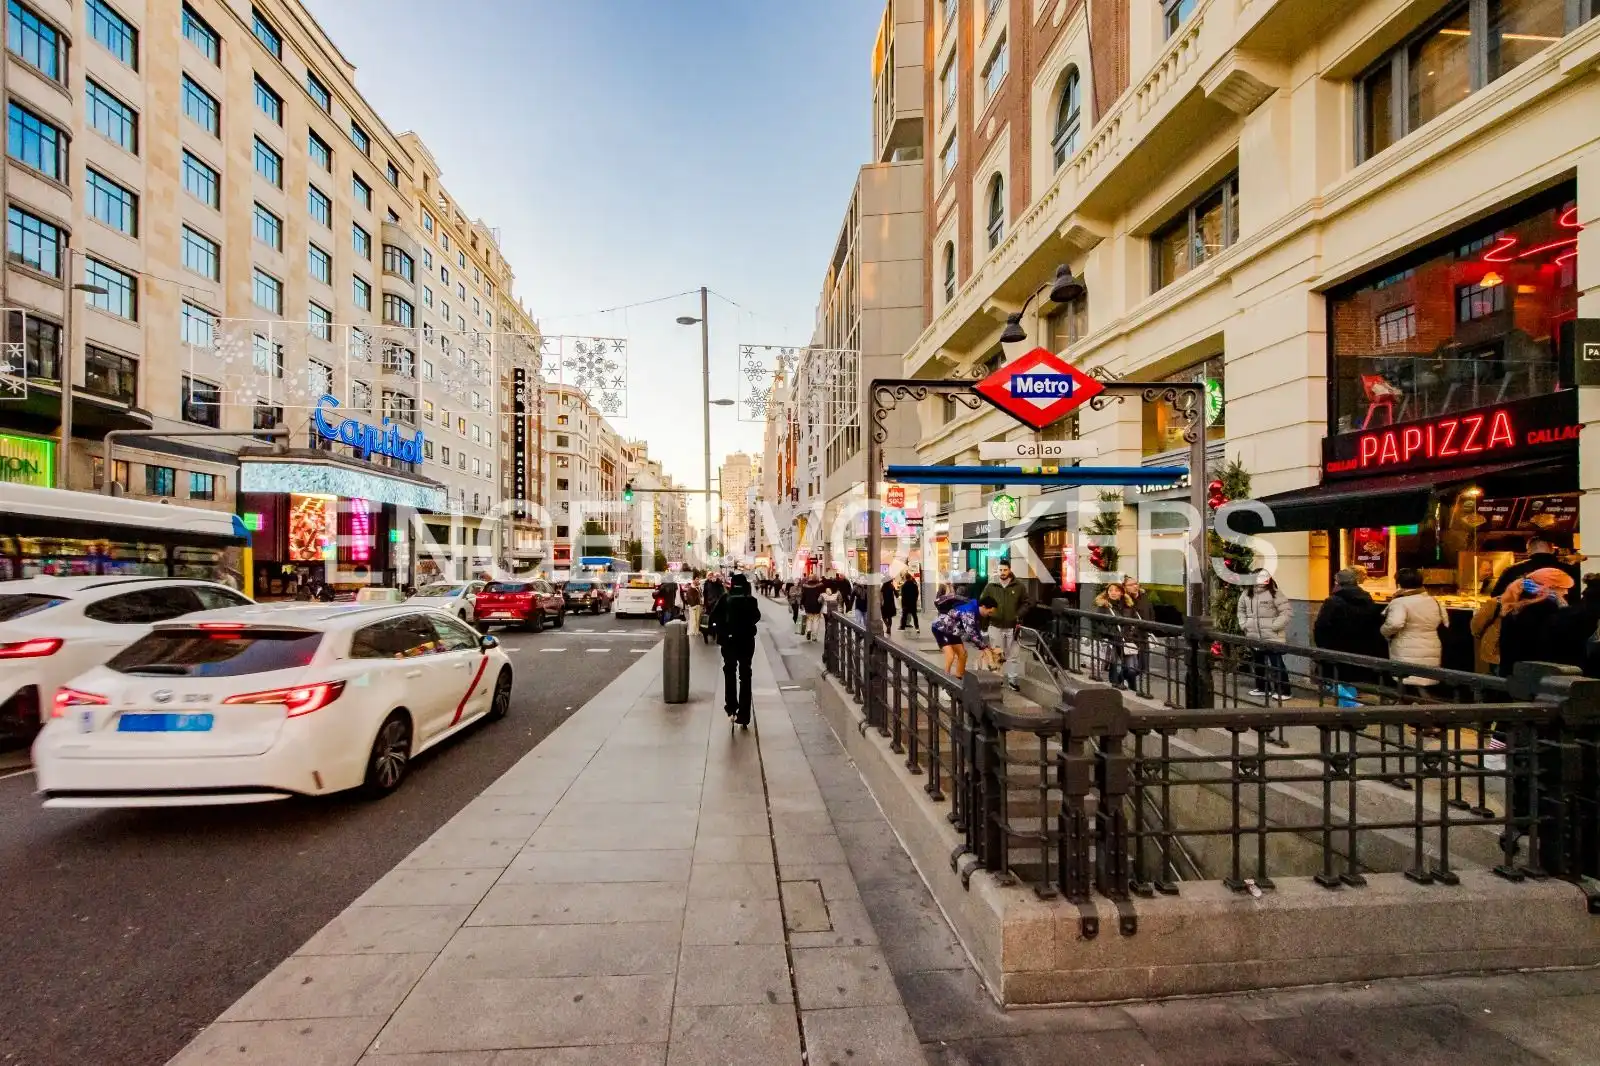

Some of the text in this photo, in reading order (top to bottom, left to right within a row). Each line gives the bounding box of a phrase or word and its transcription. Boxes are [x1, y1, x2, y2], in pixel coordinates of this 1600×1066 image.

[1017, 377, 1070, 393] Metro
[314, 393, 425, 465] Capitol
[1017, 444, 1062, 456] Callao
[1360, 410, 1515, 468] PAPIZZA
[516, 452, 524, 515] MACARENA
